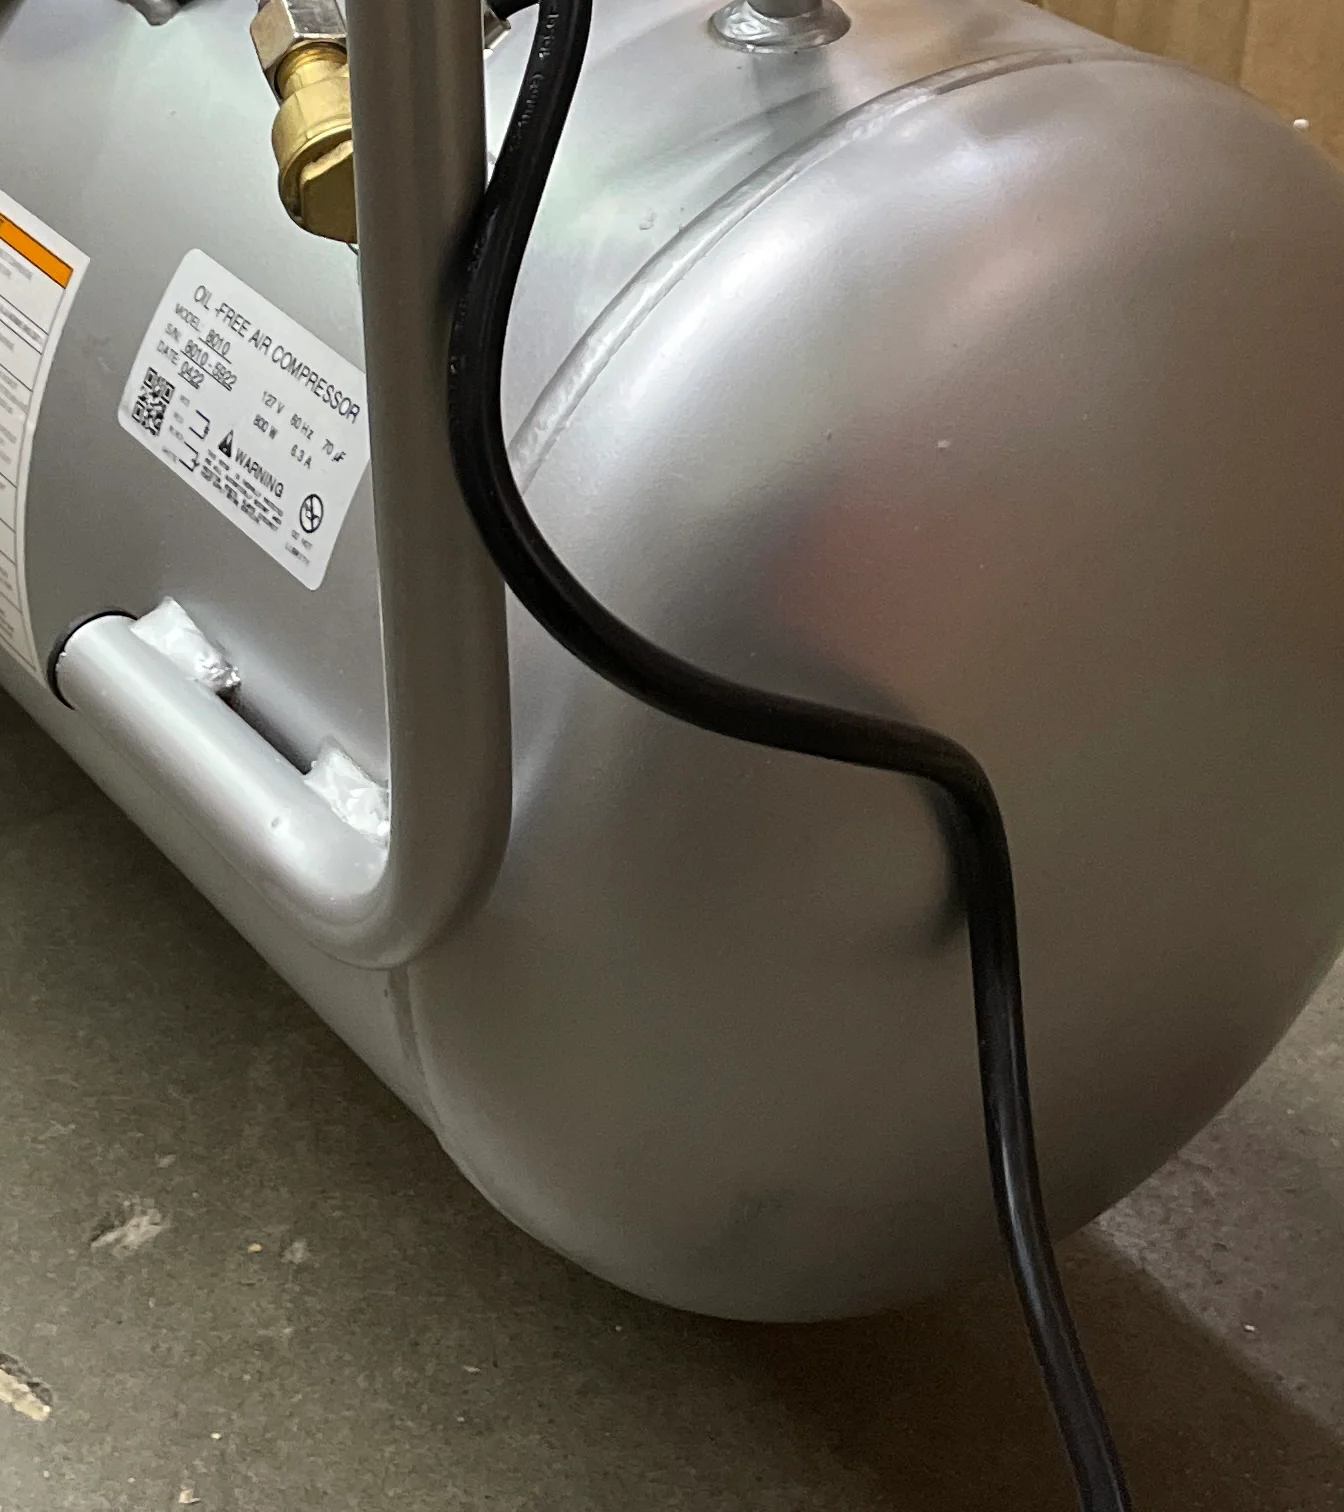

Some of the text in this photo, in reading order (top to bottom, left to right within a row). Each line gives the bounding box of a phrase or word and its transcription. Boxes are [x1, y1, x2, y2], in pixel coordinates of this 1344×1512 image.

[248, 329, 273, 356] AIR
[271, 345, 361, 424] COMPRESSOR
[235, 448, 285, 499] WARNING
